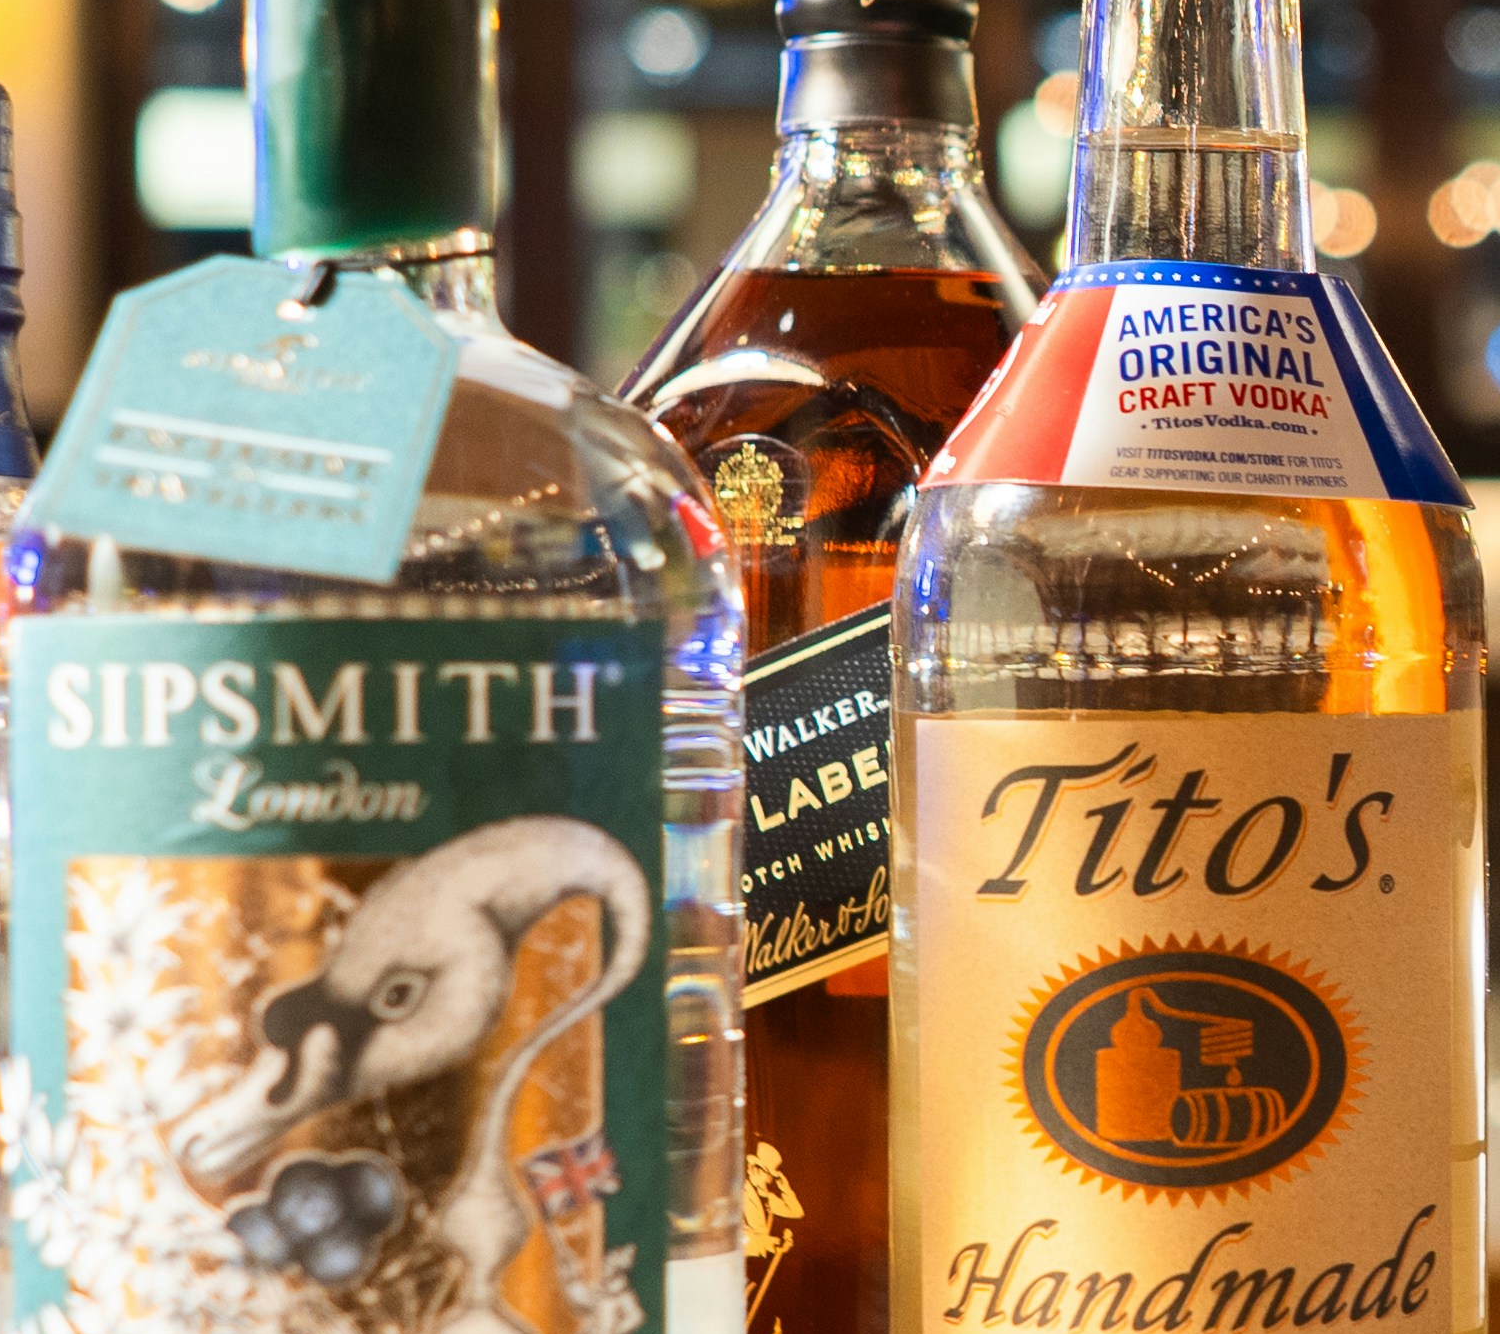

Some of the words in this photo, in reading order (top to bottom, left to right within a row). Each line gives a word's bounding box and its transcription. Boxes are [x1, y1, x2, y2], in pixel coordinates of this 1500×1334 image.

[1118, 303, 1317, 345] AMERICA'S
[1119, 339, 1325, 388] ORIGINAL
[1118, 382, 1216, 414] CRAFT
[1110, 466, 1139, 478] GEAR
[1143, 468, 1216, 483] SUPPORTING
[1218, 471, 1242, 483] OUR
[1246, 472, 1292, 487] CHARITY
[1295, 475, 1348, 488] PARTNERS
[1116, 446, 1143, 459] VISIT
[1146, 448, 1285, 466] TITOSVODKA.COM/STORE
[1288, 455, 1308, 468] FOR
[1311, 457, 1343, 469] TITO'S
[46, 660, 606, 751] SIPSMITH
[742, 689, 879, 763] WALKER
[190, 758, 427, 832] London
[750, 739, 891, 833] LABE
[975, 740, 1395, 902] Tito's
[741, 853, 802, 894] OTCH
[742, 900, 838, 973] Walker
